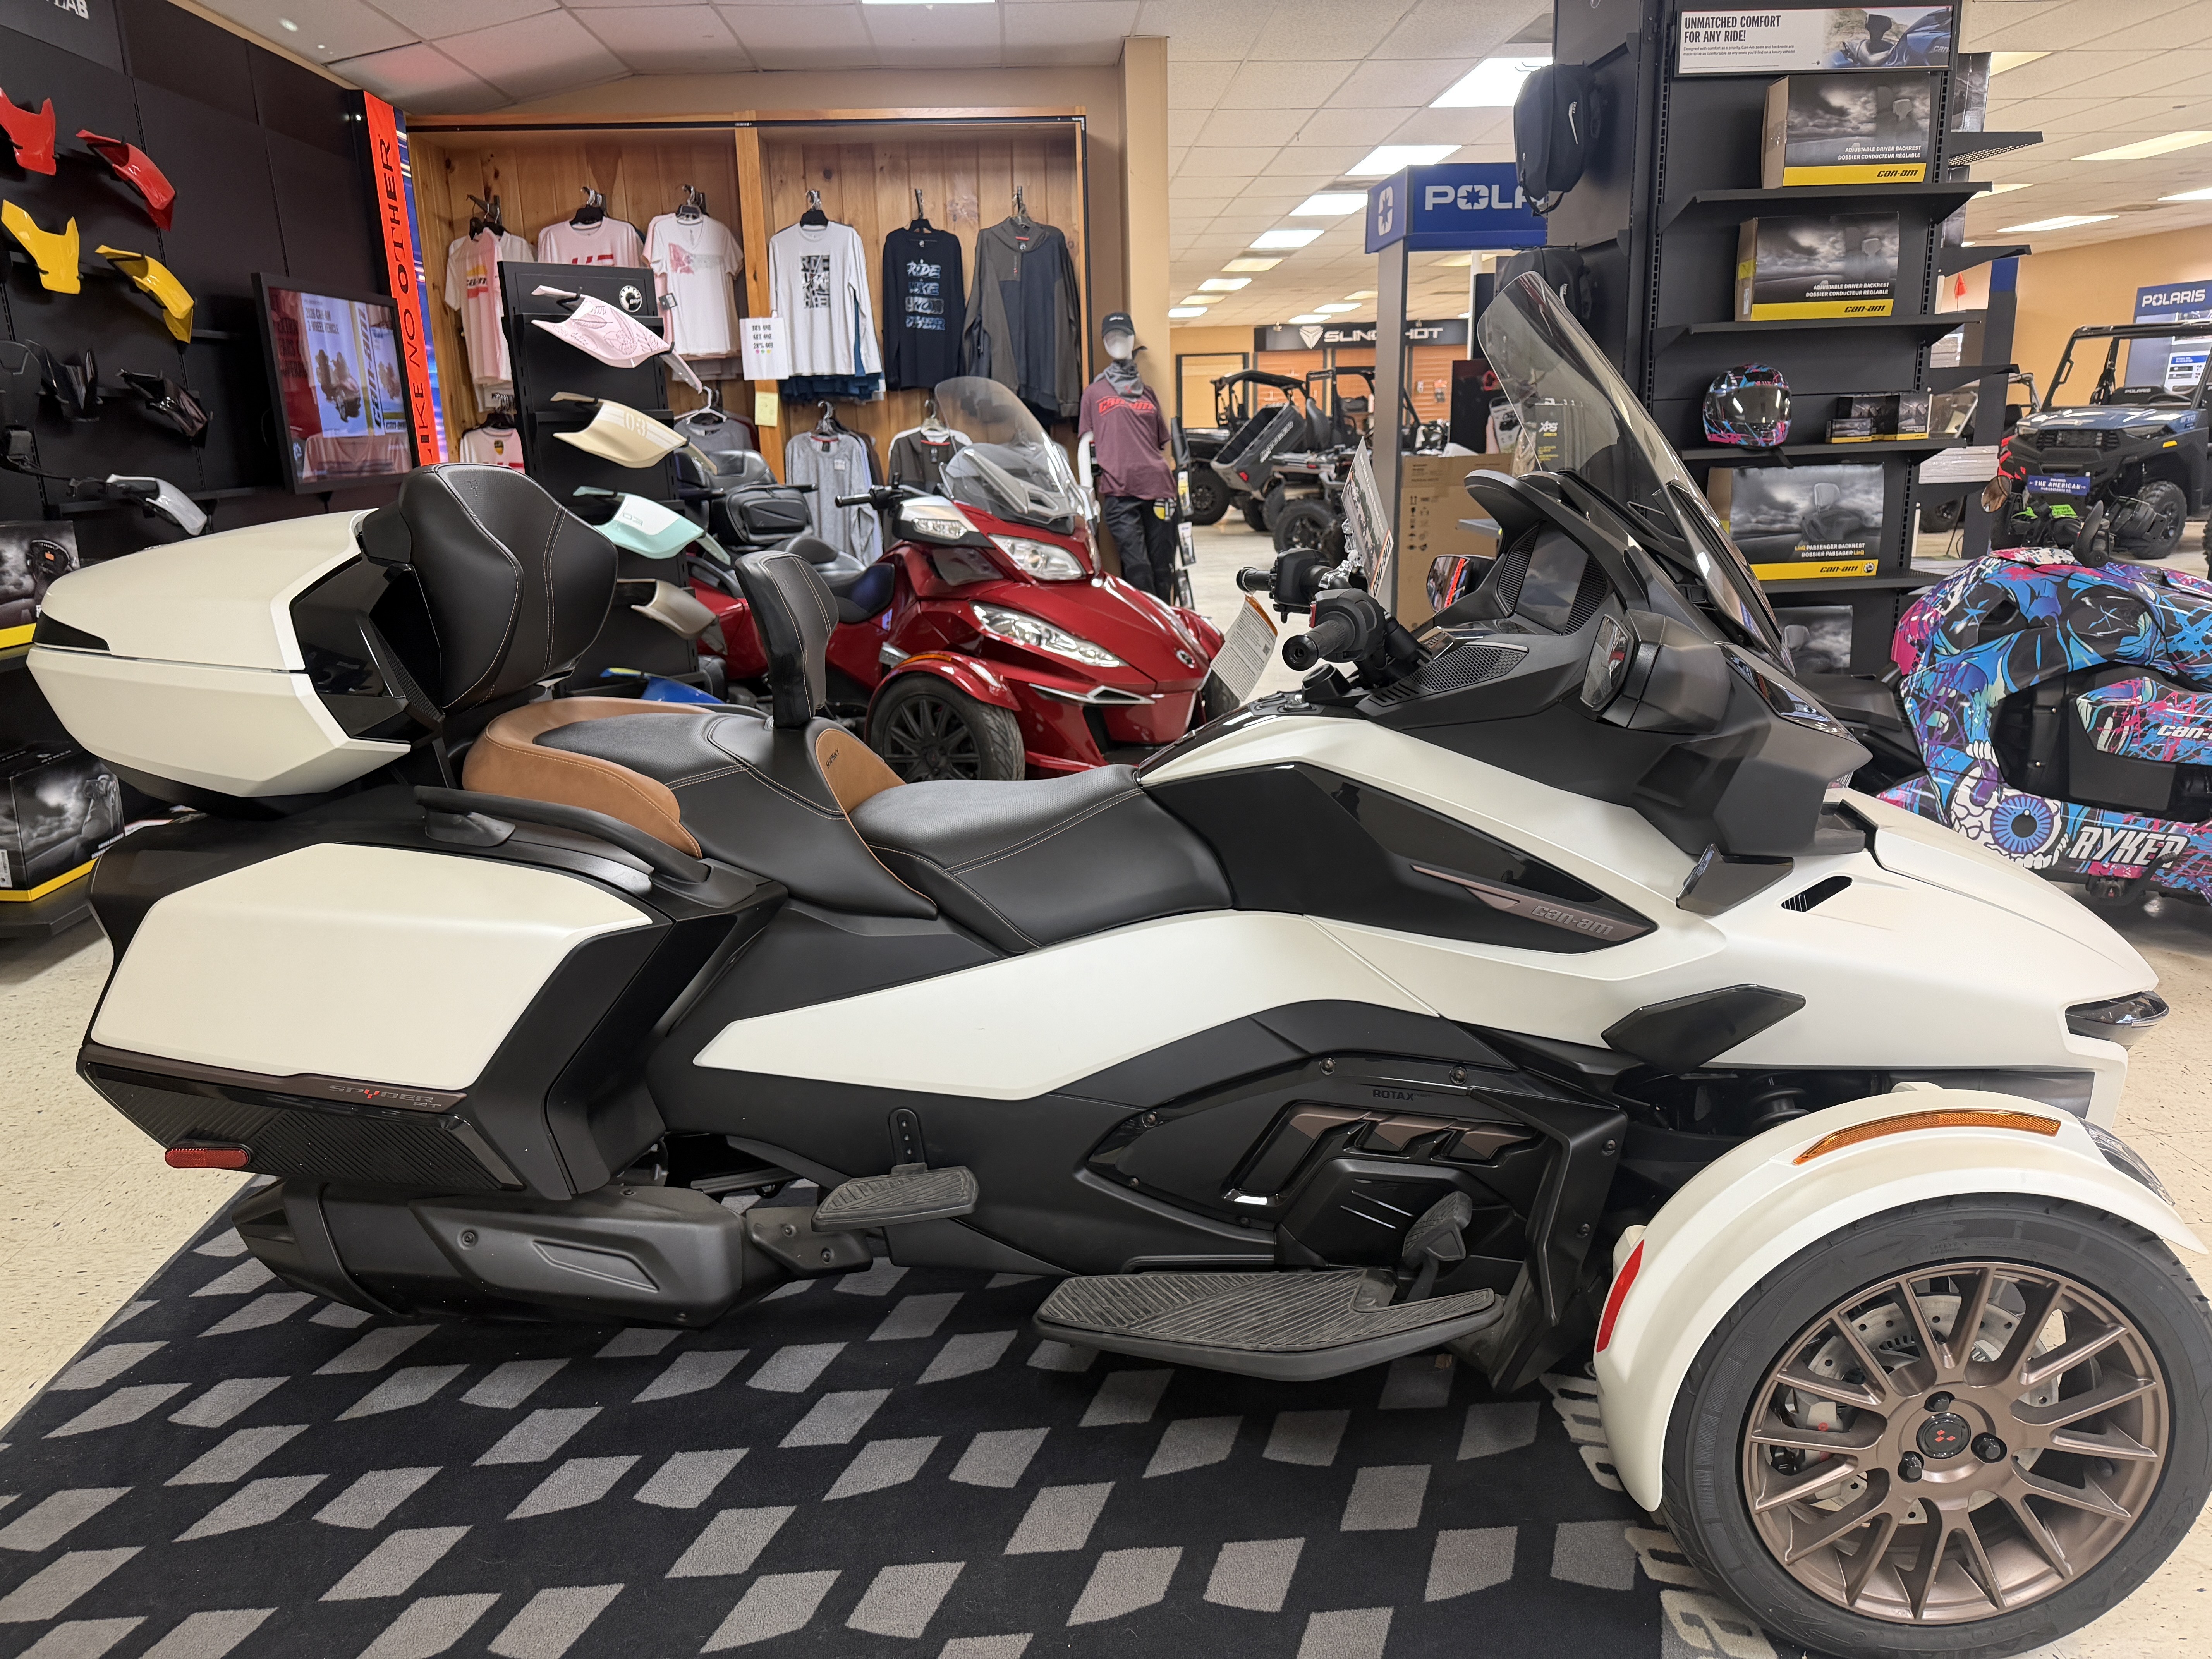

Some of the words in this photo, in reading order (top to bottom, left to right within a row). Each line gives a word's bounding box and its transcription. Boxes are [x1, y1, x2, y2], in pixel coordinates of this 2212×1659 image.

[1685, 16, 1737, 29] UNMATCHED
[1740, 15, 1781, 27] COMFORT
[1685, 31, 1700, 43] FOR
[1703, 30, 1721, 42] ANY
[1724, 30, 1746, 41] RIDE!
[380, 137, 409, 294] OTHER
[2142, 289, 2205, 307] POLARIS
[404, 308, 421, 368] NO
[2048, 482, 2081, 490] AMERICAN
[1373, 536, 1391, 598] can-am
[2157, 725, 2212, 740] can-
[2069, 826, 2190, 868] RYKER
[1532, 905, 1613, 935] can-am
[329, 1085, 433, 1103] SPYDER
[1373, 1089, 1413, 1101] ROTAX
